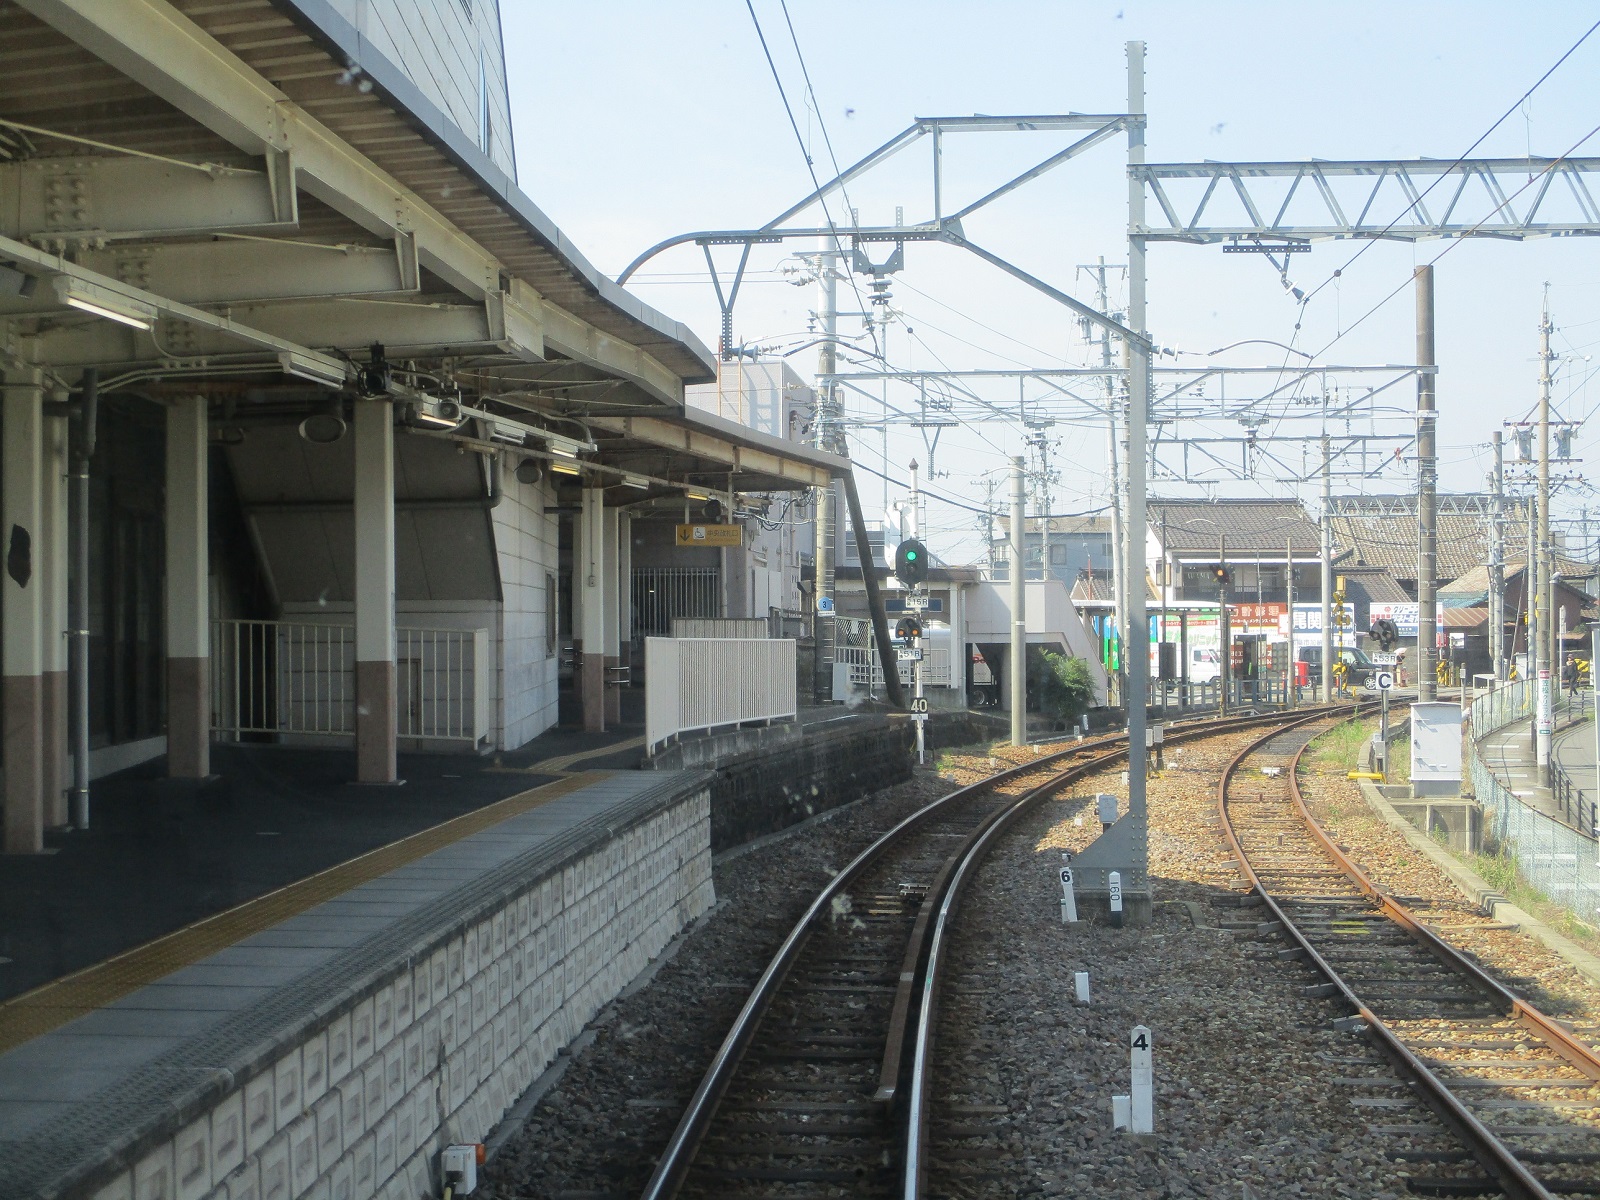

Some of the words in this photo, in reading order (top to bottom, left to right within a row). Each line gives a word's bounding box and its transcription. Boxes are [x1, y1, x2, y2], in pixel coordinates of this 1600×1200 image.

[1378, 673, 1391, 689] C
[911, 699, 928, 712] 40
[1061, 871, 1071, 882] 6
[1133, 1033, 1149, 1051] 4
